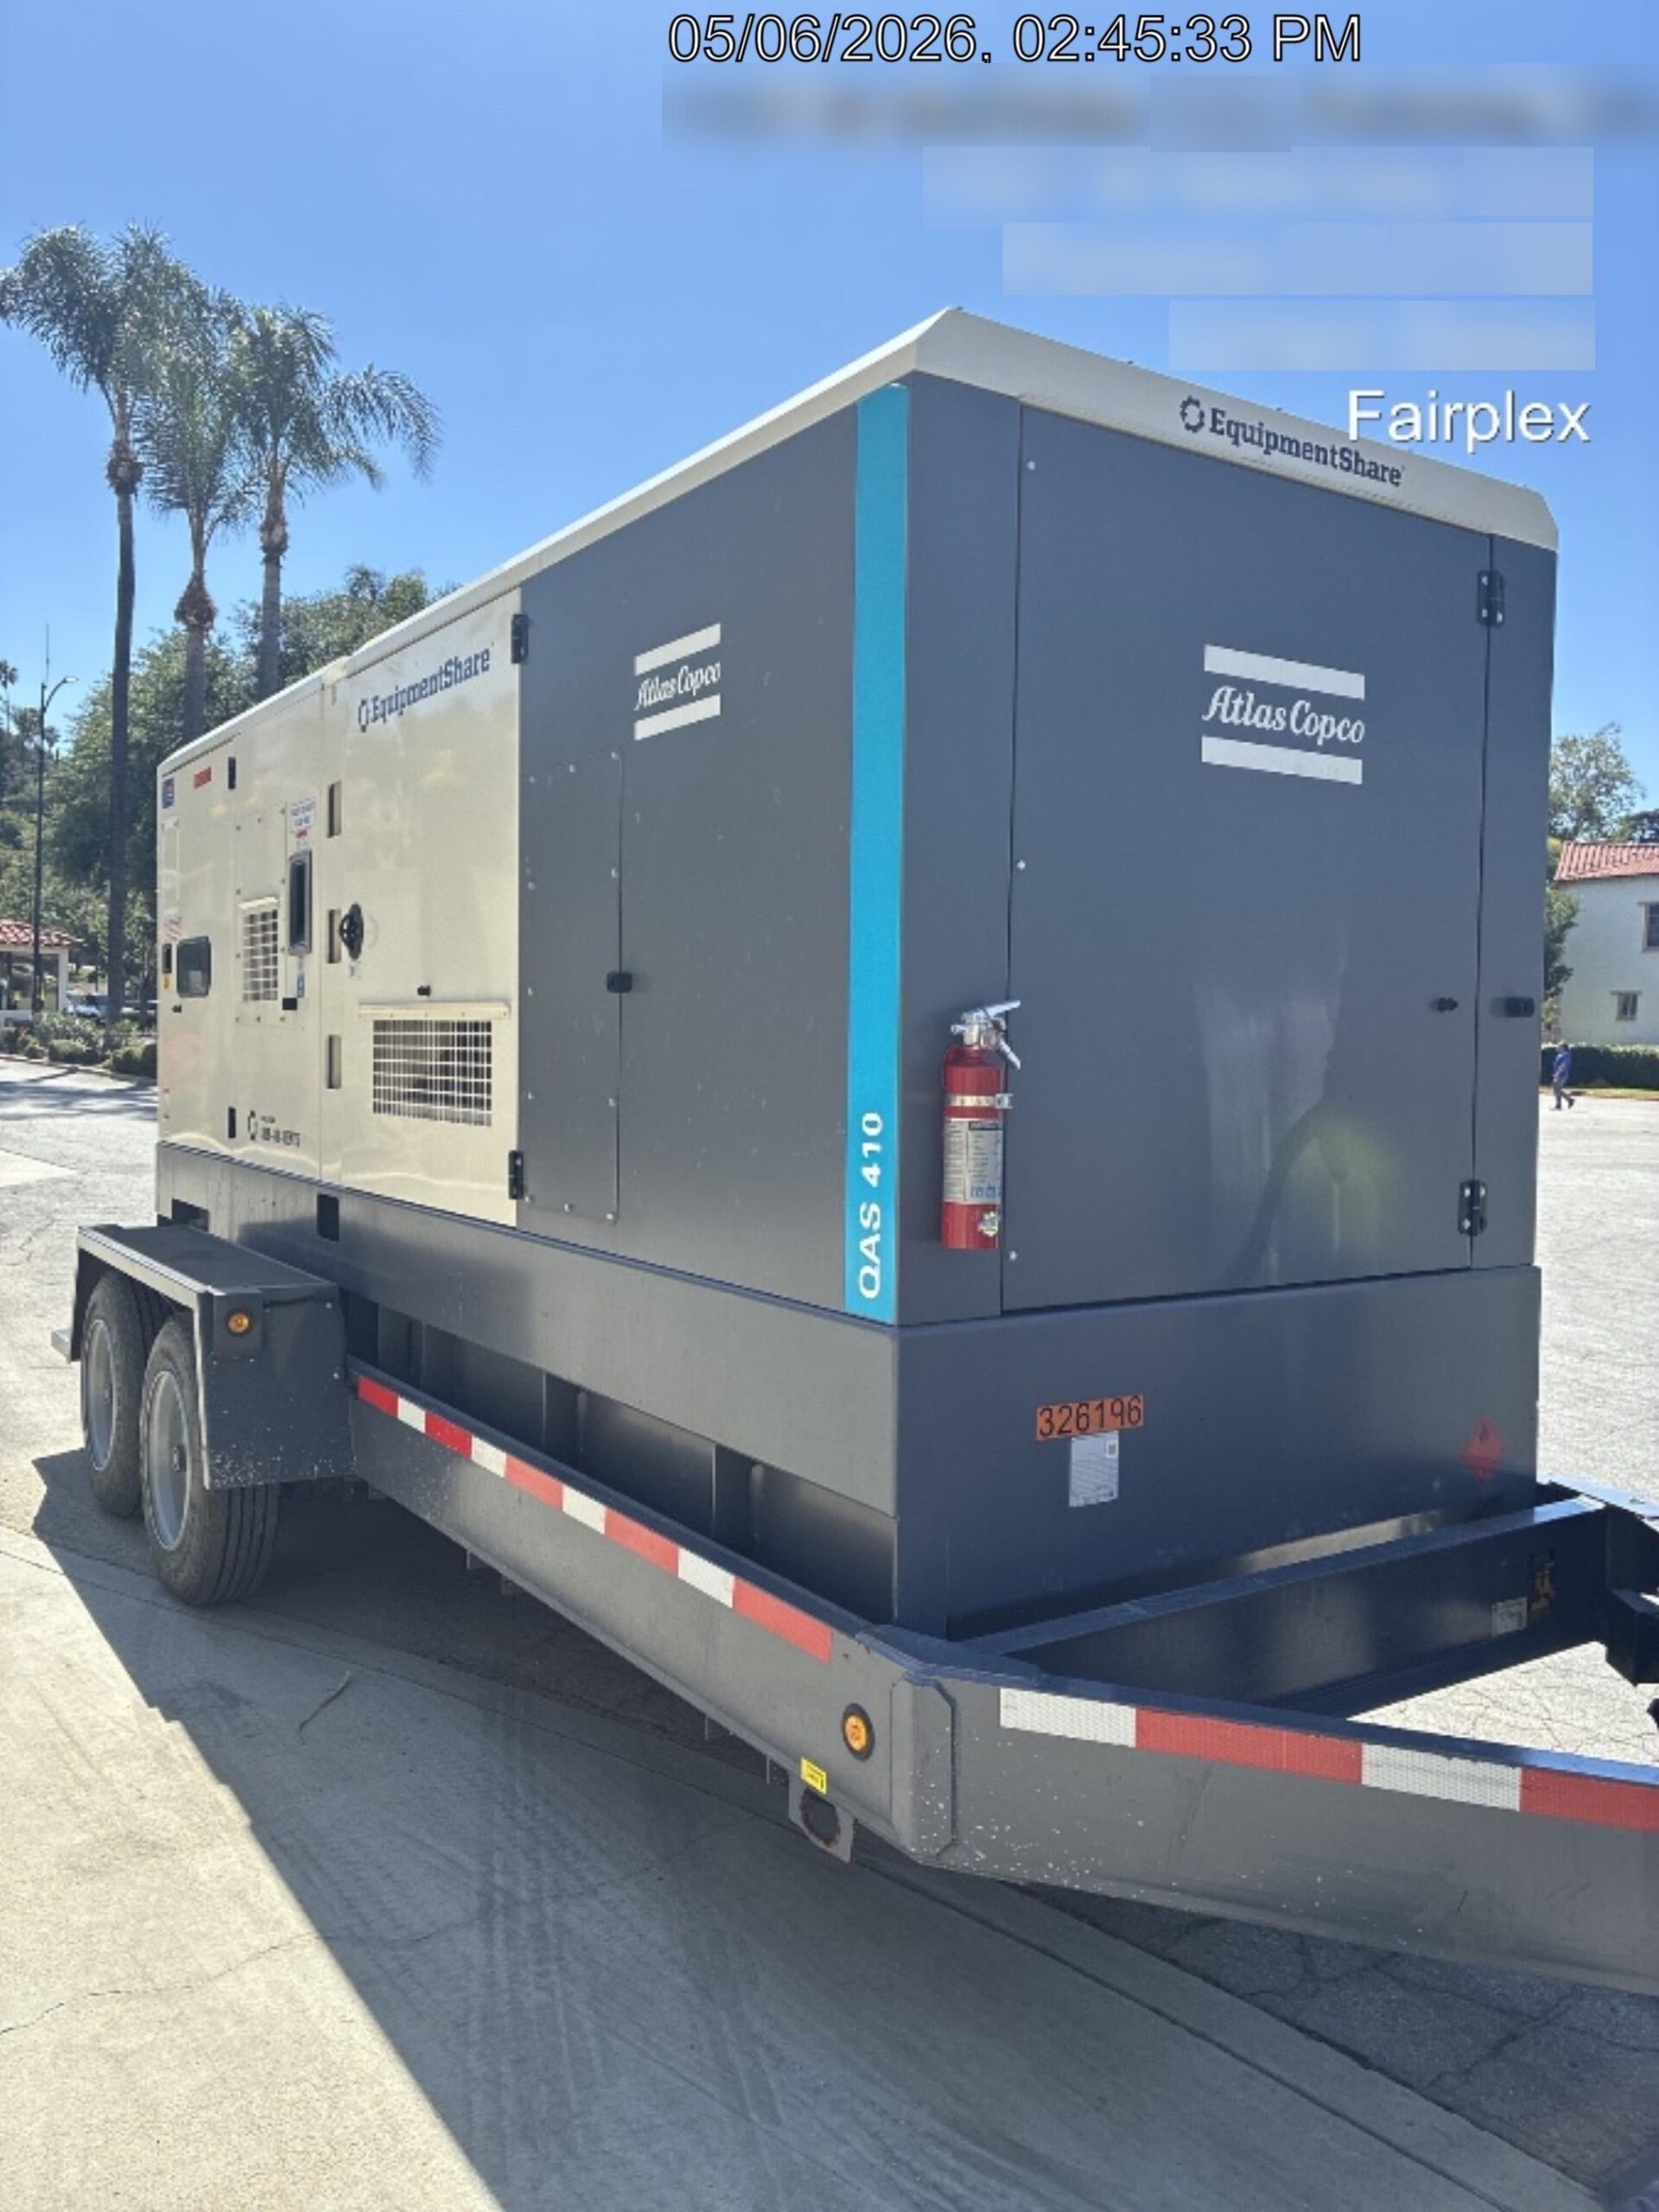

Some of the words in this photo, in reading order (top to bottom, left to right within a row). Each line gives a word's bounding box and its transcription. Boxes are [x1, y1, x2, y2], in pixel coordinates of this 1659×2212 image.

[1209, 407, 1402, 487] EquipmentShare
[371, 648, 491, 724] EquipmentShare
[861, 1111, 883, 1188] 410
[858, 1202, 881, 1300] QAS
[1039, 1395, 1142, 1438] 326196
